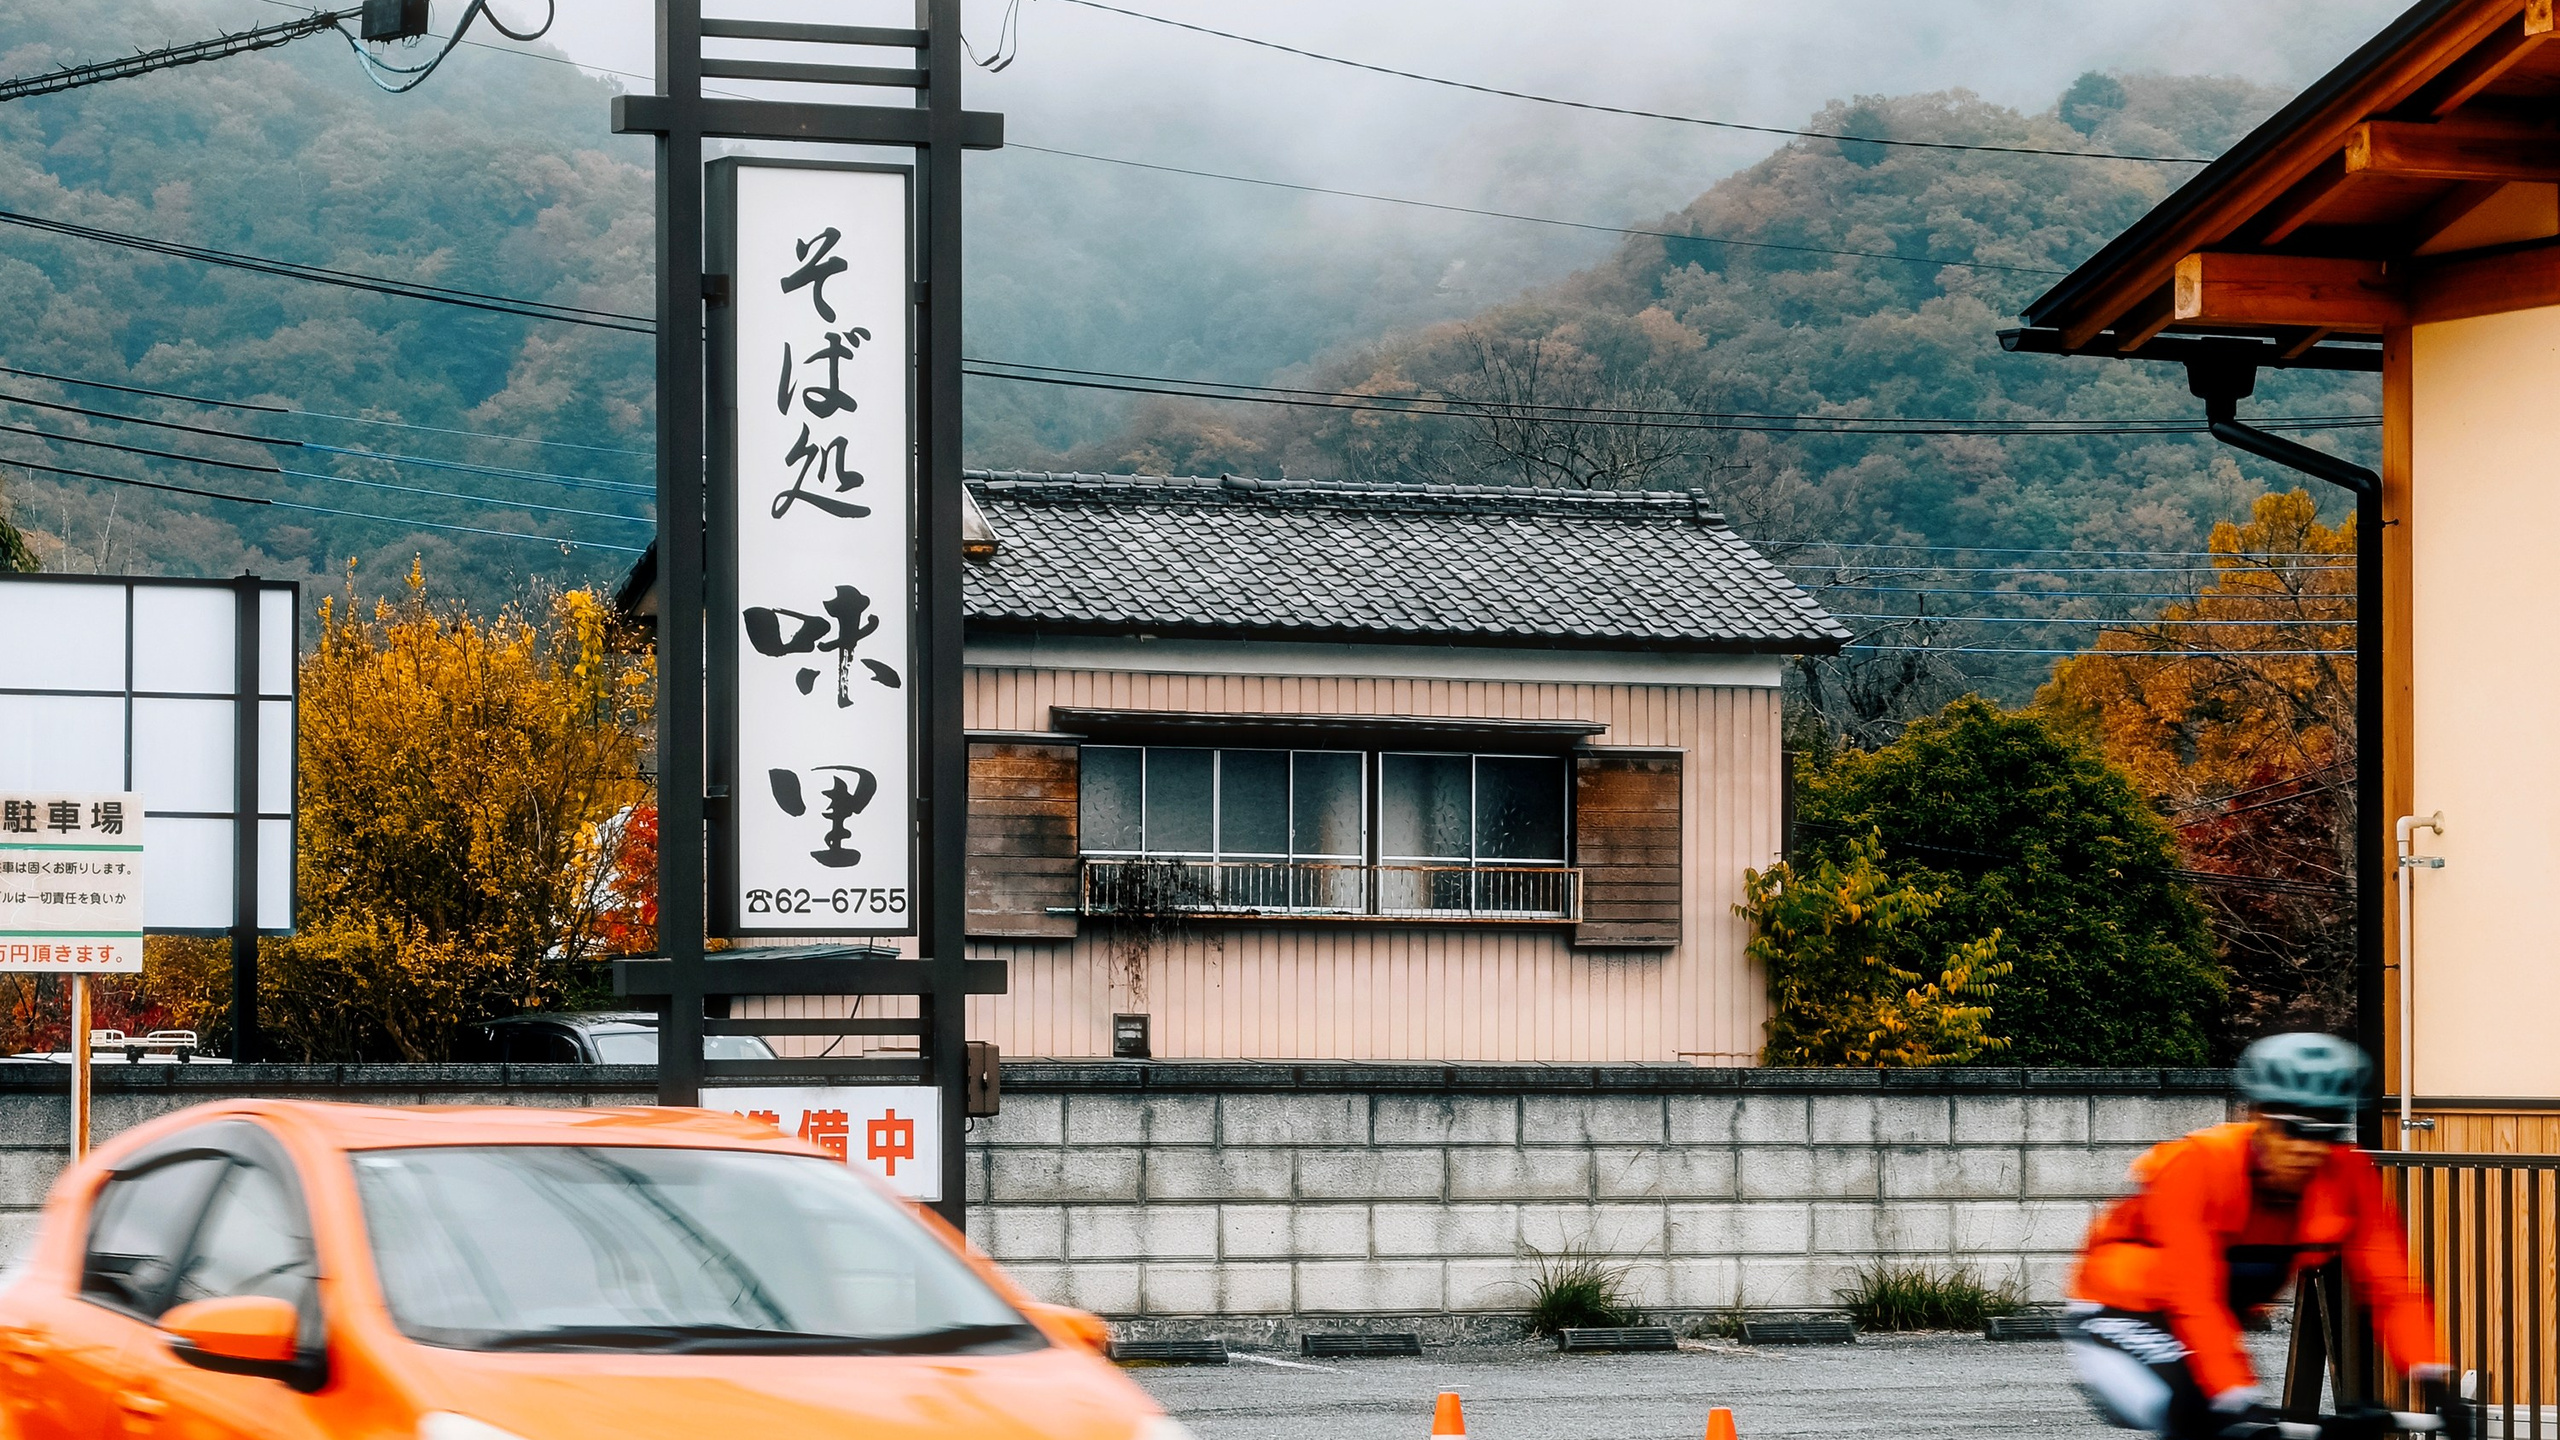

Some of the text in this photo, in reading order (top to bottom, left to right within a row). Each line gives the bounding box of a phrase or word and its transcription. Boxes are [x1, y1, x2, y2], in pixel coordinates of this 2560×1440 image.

[742, 227, 902, 868] そば処 味里
[3, 800, 124, 834] 駐車場
[0, 861, 132, 875] 車は固くお断りします。
[0, 891, 127, 905] ルは一切責任を負いか
[774, 888, 906, 914] 62-6755
[733, 1109, 914, 1176] 備中
